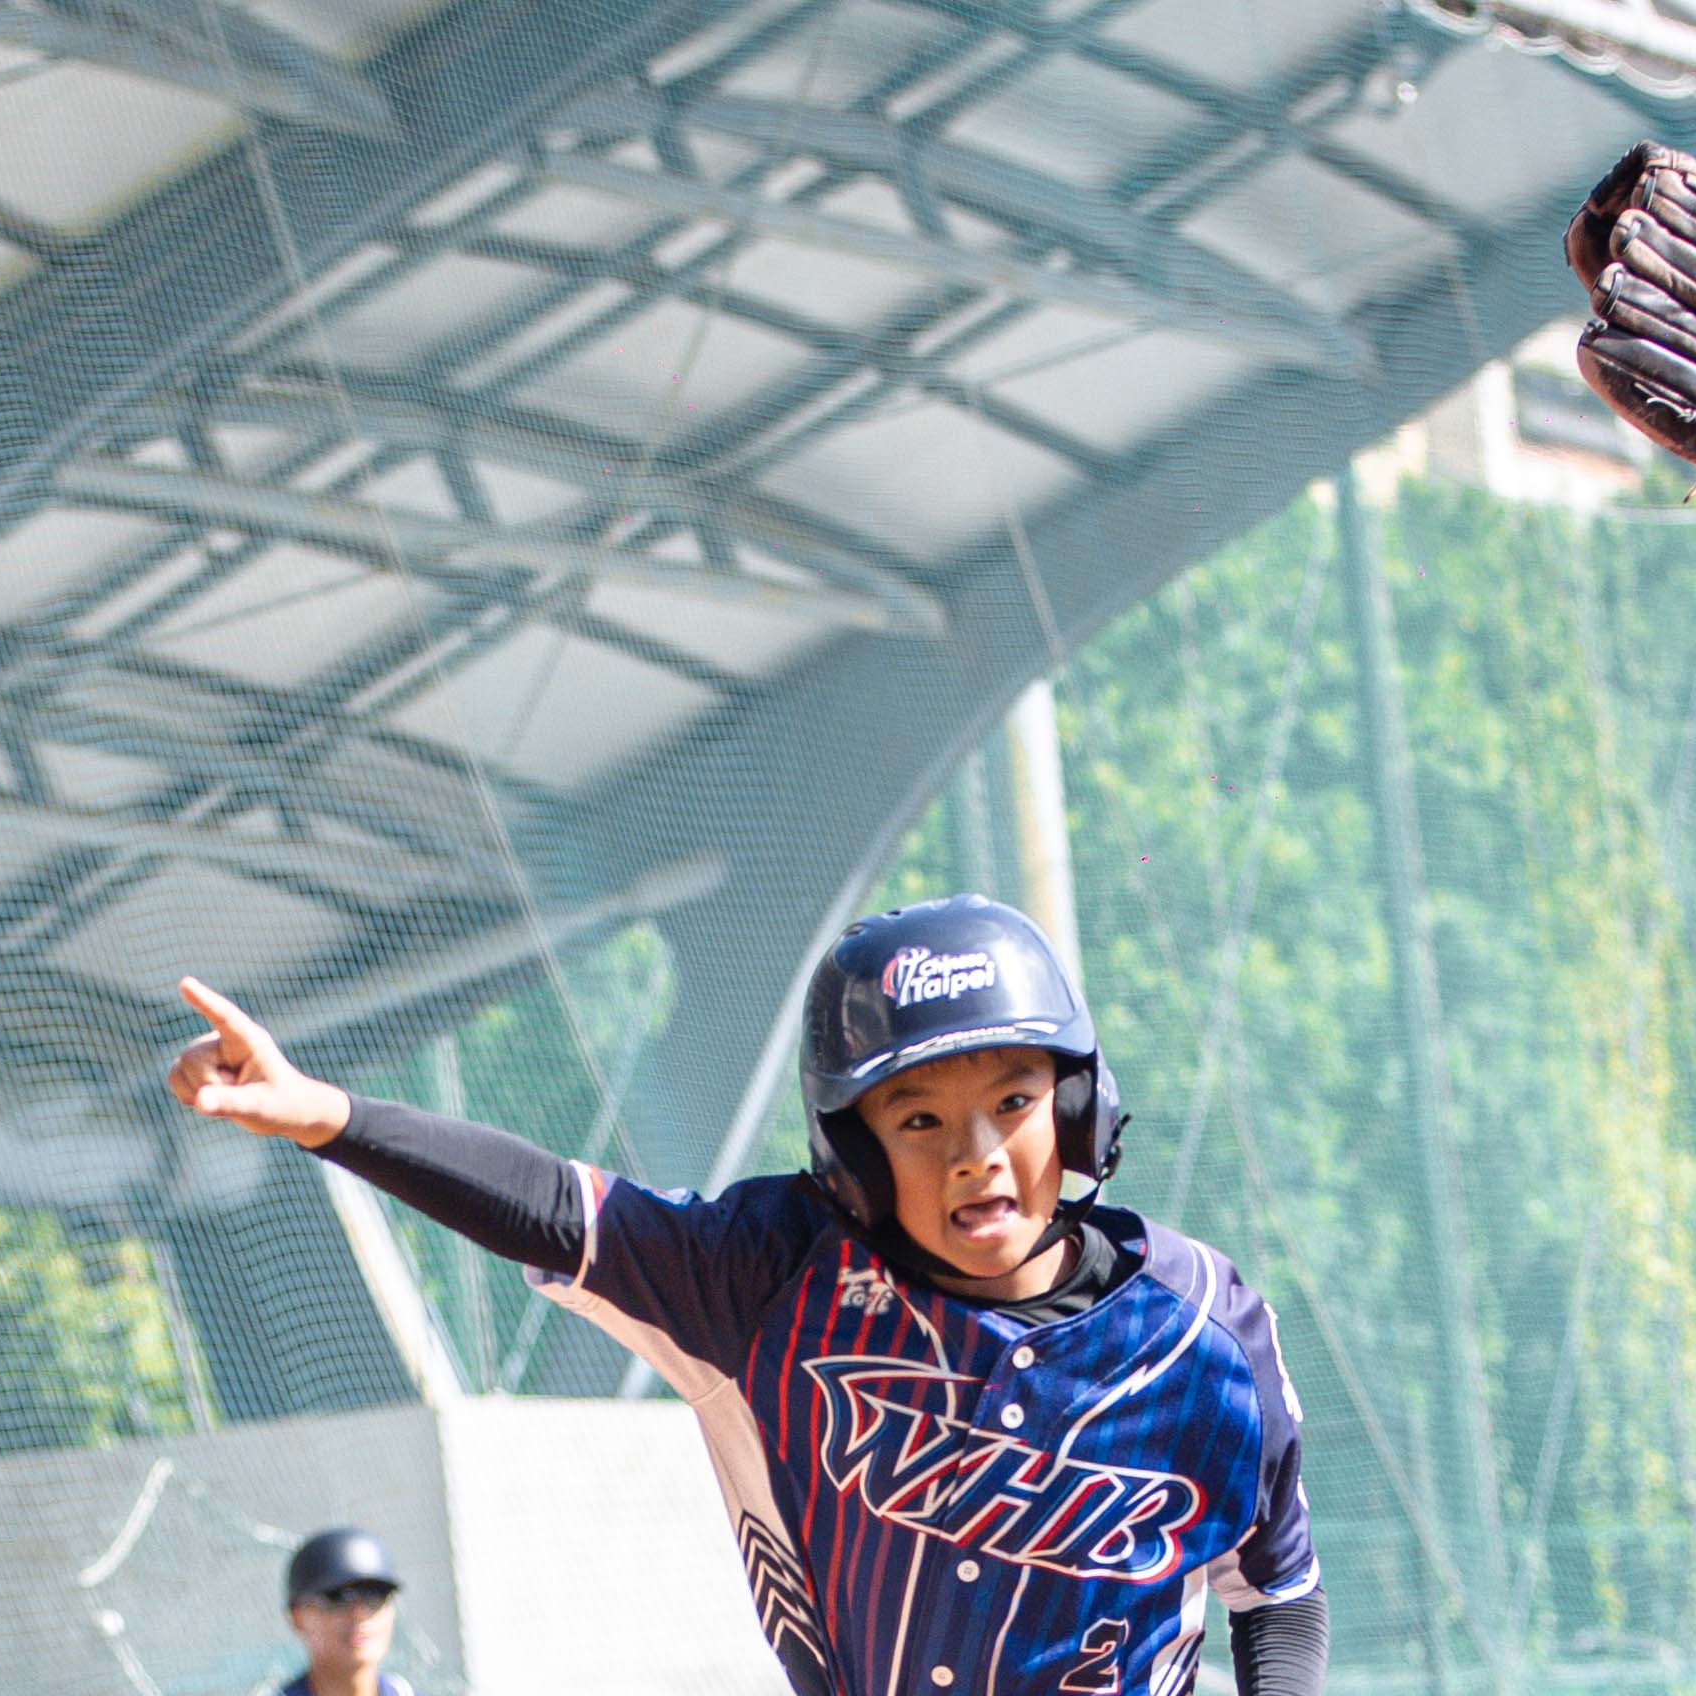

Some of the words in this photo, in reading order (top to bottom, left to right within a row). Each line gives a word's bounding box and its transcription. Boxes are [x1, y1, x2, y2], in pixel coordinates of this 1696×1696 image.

[909, 961, 995, 1002] Taipei
[800, 1355, 1209, 1585] WHB
[1057, 1617, 1130, 1695] 2
